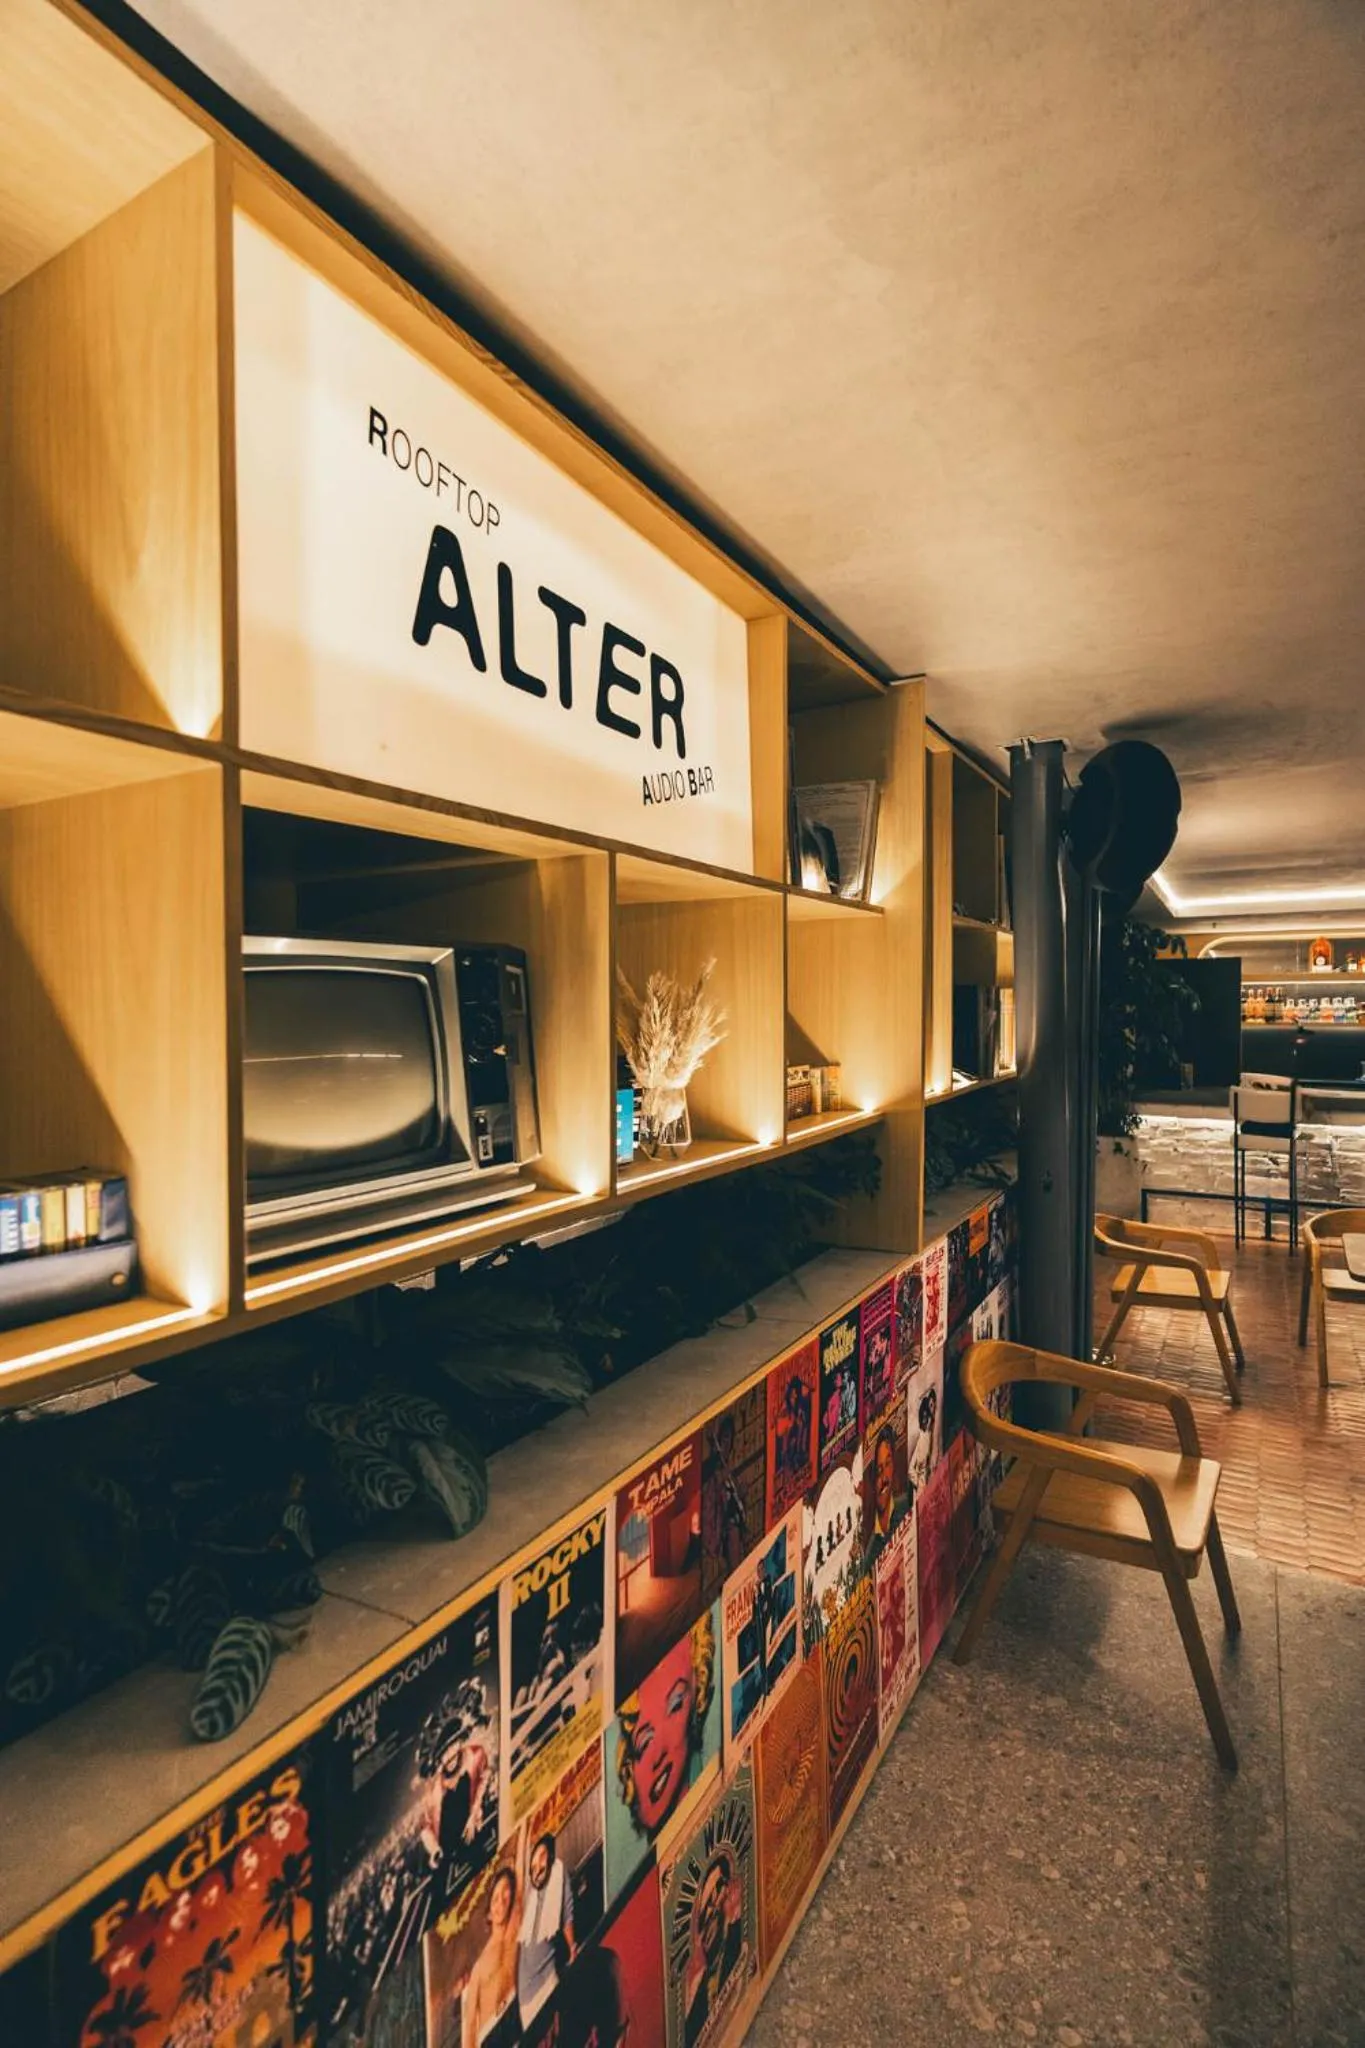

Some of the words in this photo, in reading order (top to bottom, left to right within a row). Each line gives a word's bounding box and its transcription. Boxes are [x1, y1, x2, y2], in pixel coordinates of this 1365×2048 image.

[368, 405, 501, 535] ROOFTOP
[412, 524, 686, 760] ALTER
[642, 769, 686, 806] AUDIO
[687, 765, 715, 796] BAR
[627, 1444, 693, 1510] TAME
[511, 1509, 606, 1609] ROCKY
[547, 1571, 571, 1620] II
[333, 1636, 448, 1742] JAMIROQUAI
